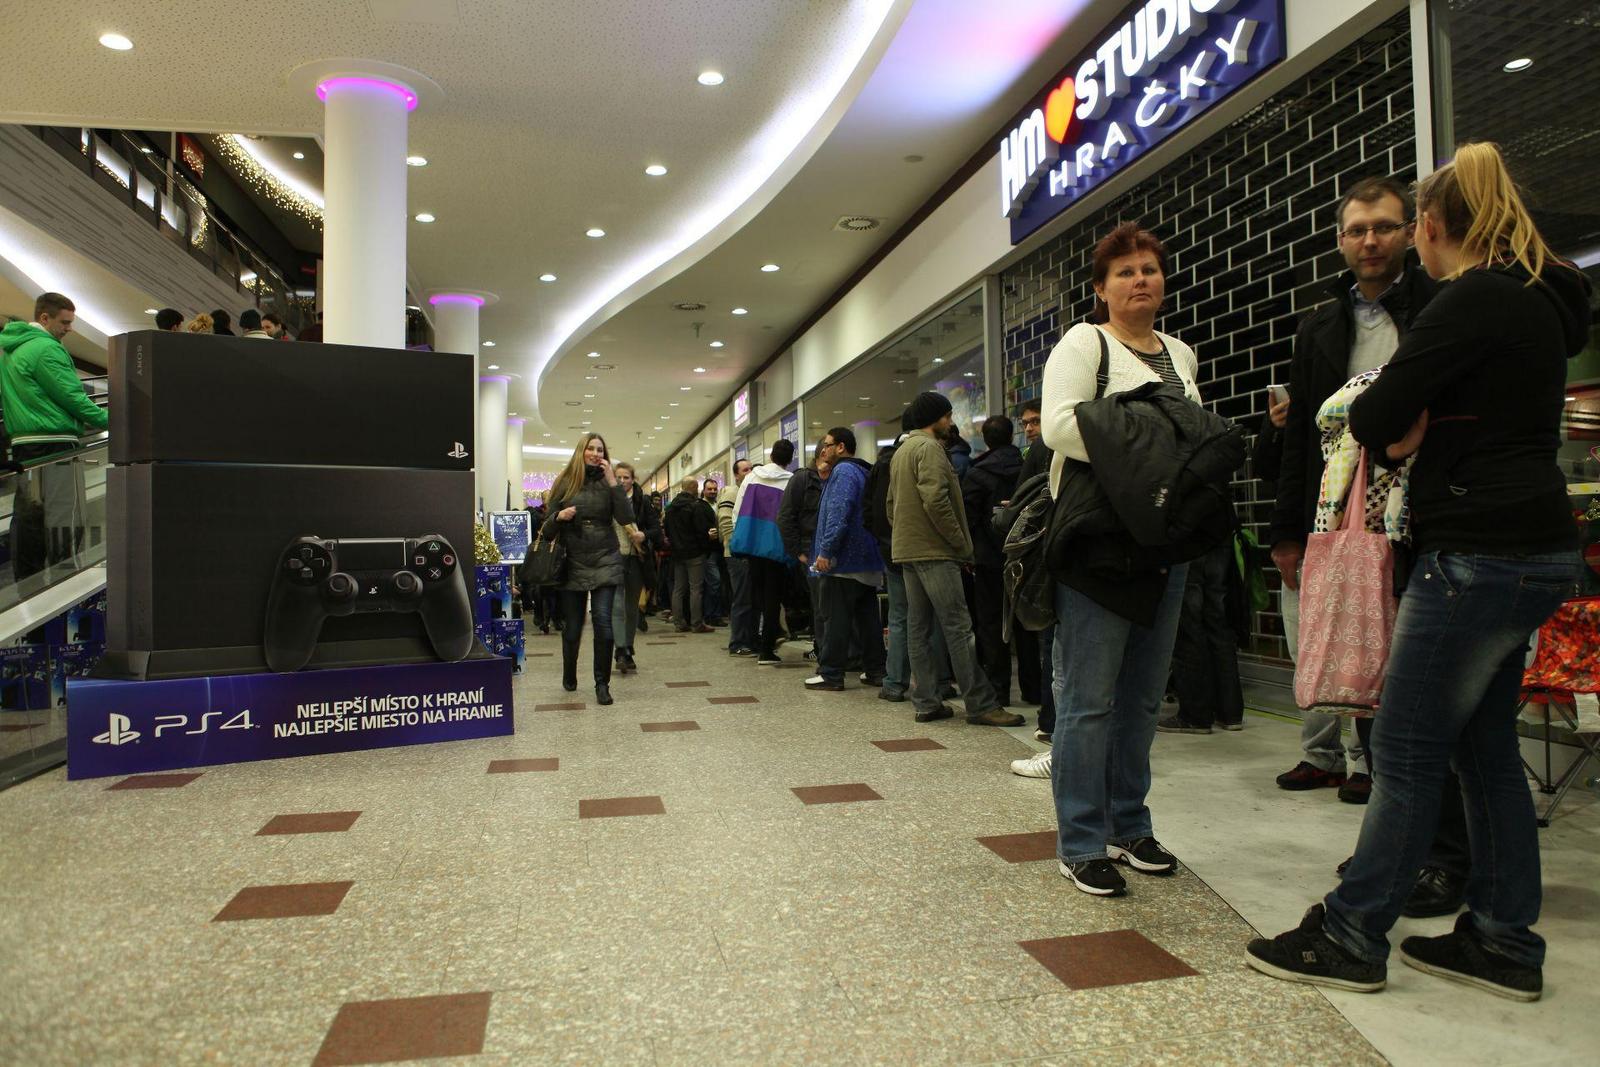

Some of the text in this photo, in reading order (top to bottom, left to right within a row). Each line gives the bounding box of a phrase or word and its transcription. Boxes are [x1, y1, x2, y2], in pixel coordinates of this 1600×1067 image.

[1001, 0, 1230, 219] HM STUDI
[1050, 17, 1246, 198] HRAČKY
[296, 686, 484, 719] NEJLEPŠÍ MÍSTO K HRANÍ
[154, 709, 254, 738] PS4
[273, 703, 504, 739] NAJLEPŠIE MIESTO NA HRANIE
